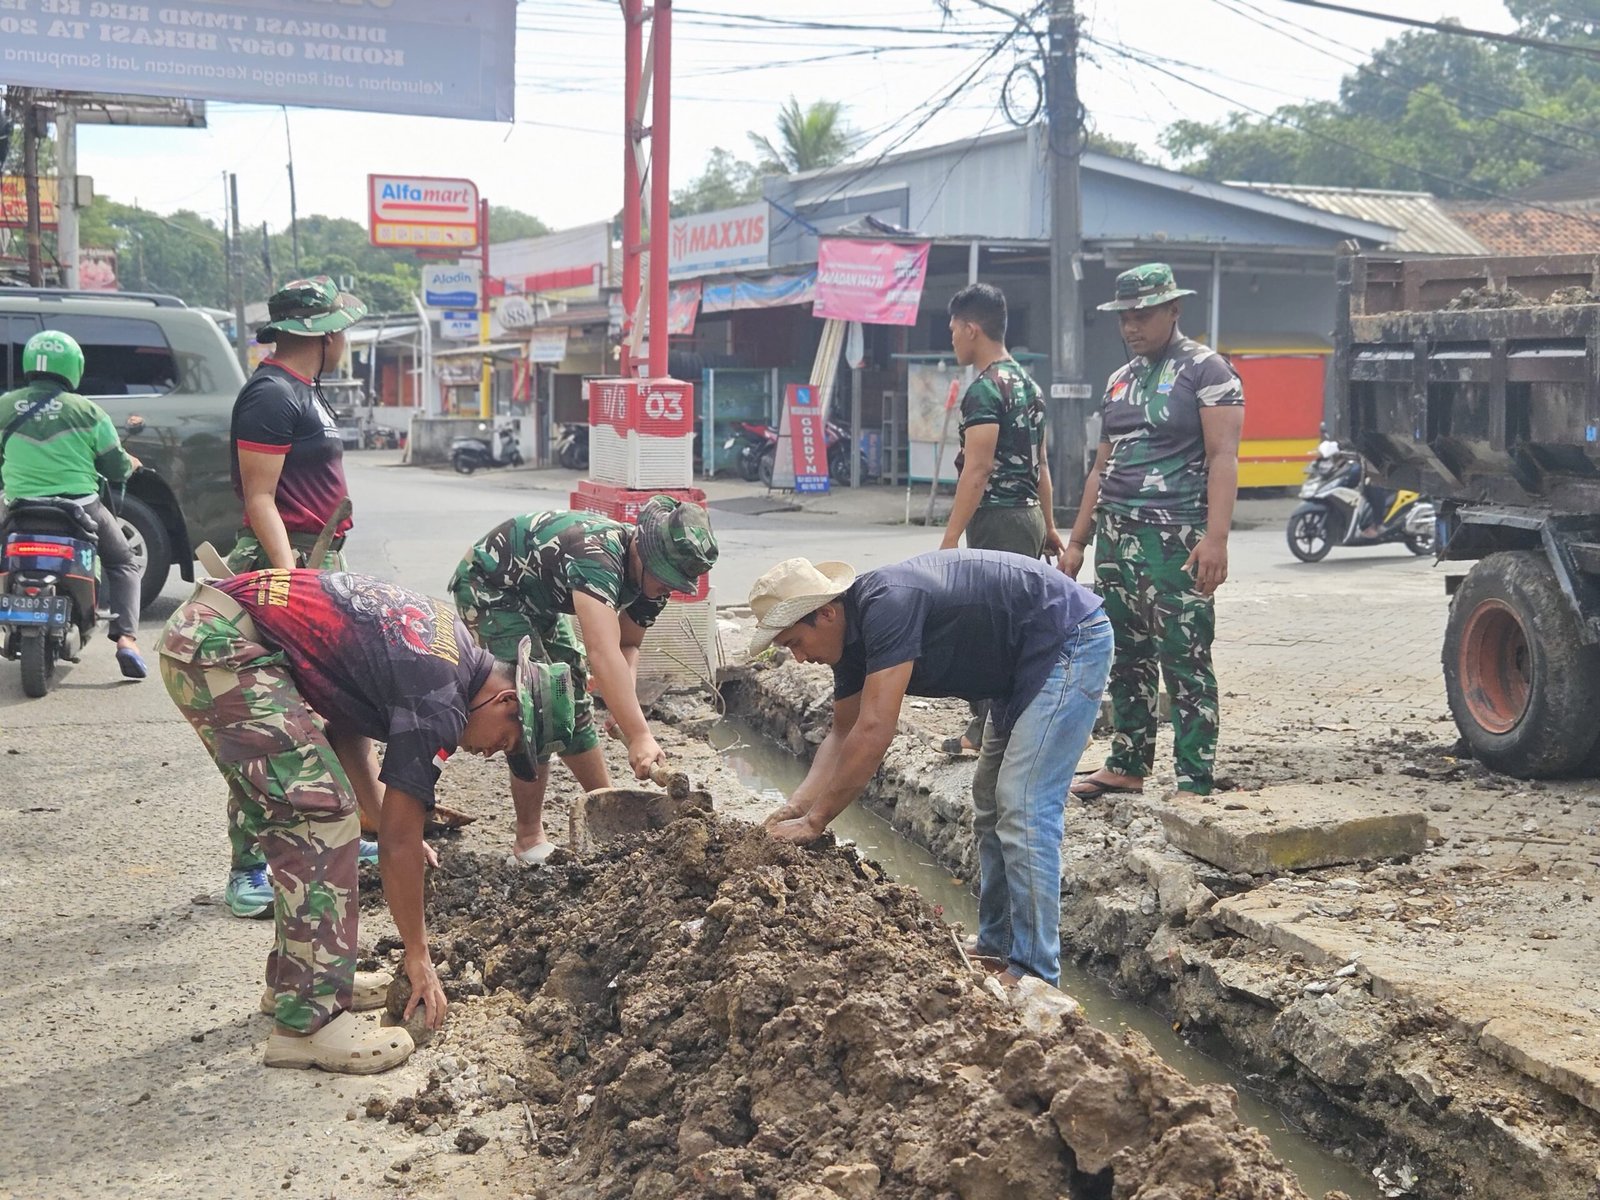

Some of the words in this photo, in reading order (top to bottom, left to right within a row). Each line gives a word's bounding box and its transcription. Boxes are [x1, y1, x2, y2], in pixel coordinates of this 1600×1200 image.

[381, 182, 470, 204] Alfamart
[688, 214, 764, 253] MAXXIS
[452, 321, 471, 329] ATM
[14, 398, 63, 412] Gb
[645, 393, 684, 421] 03
[801, 416, 818, 474] GORDYN
